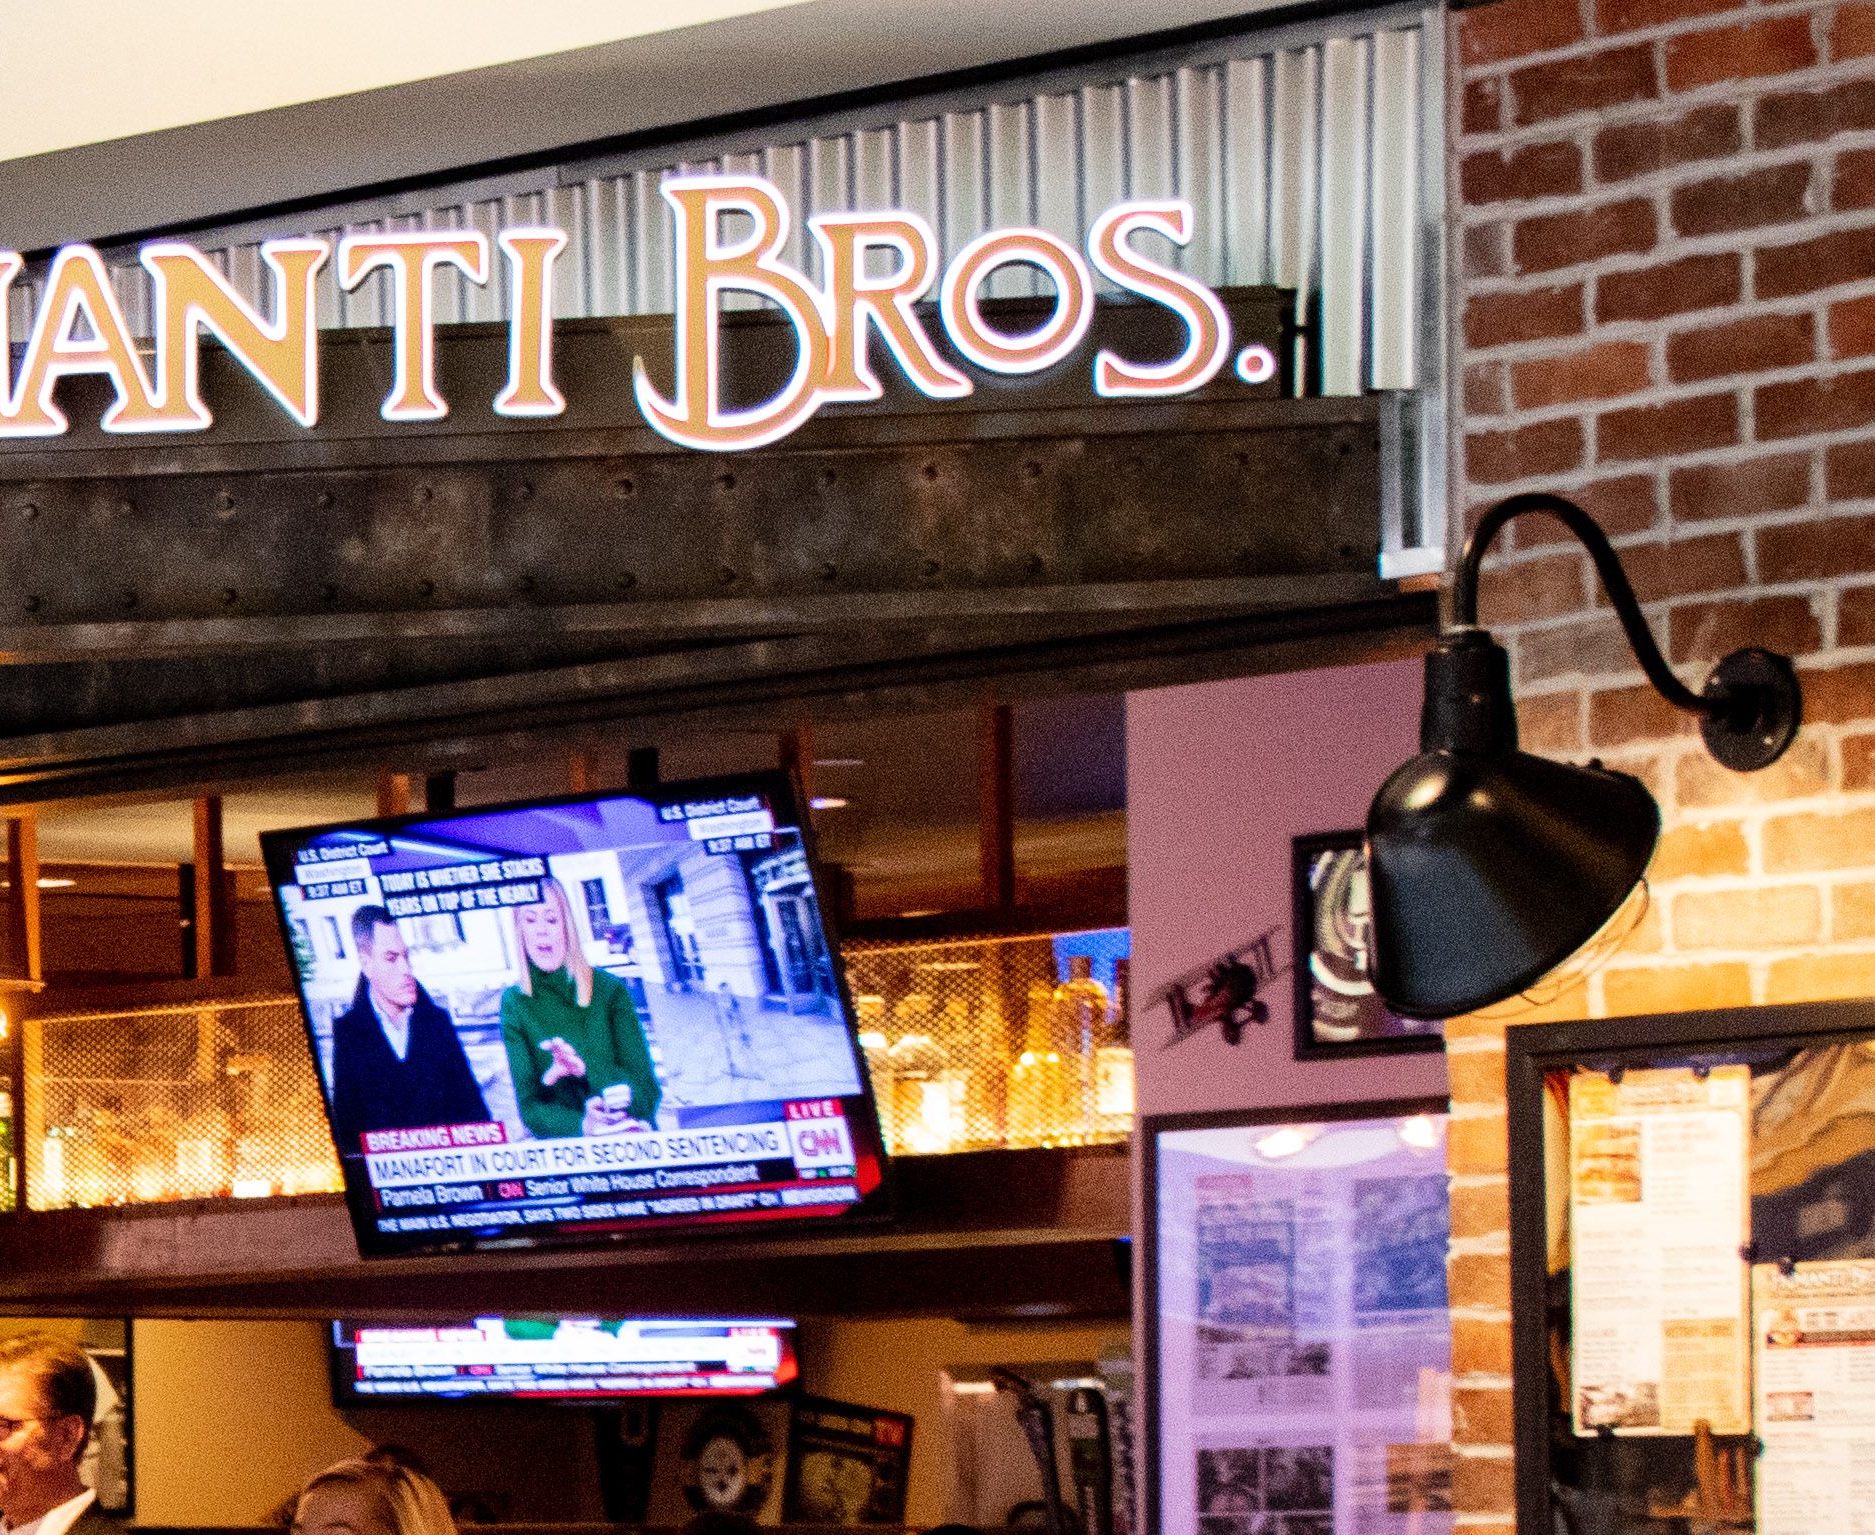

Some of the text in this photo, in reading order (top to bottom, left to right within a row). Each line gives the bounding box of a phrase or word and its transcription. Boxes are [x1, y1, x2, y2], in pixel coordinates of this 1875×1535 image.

[633, 174, 1273, 453] BROS.
[358, 841, 388, 857] Court
[380, 872, 415, 892] TODAY
[416, 871, 429, 888] IS
[428, 865, 479, 887] WHETHER
[501, 857, 546, 879] STACKS
[386, 896, 422, 916] YEARS
[438, 892, 459, 910] TOP
[460, 890, 476, 908] OF
[477, 887, 499, 907] THE
[499, 883, 540, 904] NEARLY
[787, 1100, 835, 1120] LIVE
[366, 1121, 503, 1152] BREAKING NEWS
[799, 1127, 843, 1157] CNN
[374, 1129, 779, 1181] MANAFORT IN COURT FOR SECOND SENTENCING
[380, 1186, 434, 1207] Pamela
[435, 1184, 485, 1204] Brown
[525, 1178, 570, 1197] Senior
[570, 1175, 611, 1194] White
[611, 1172, 656, 1193] House
[656, 1164, 760, 1189] Correspondent
